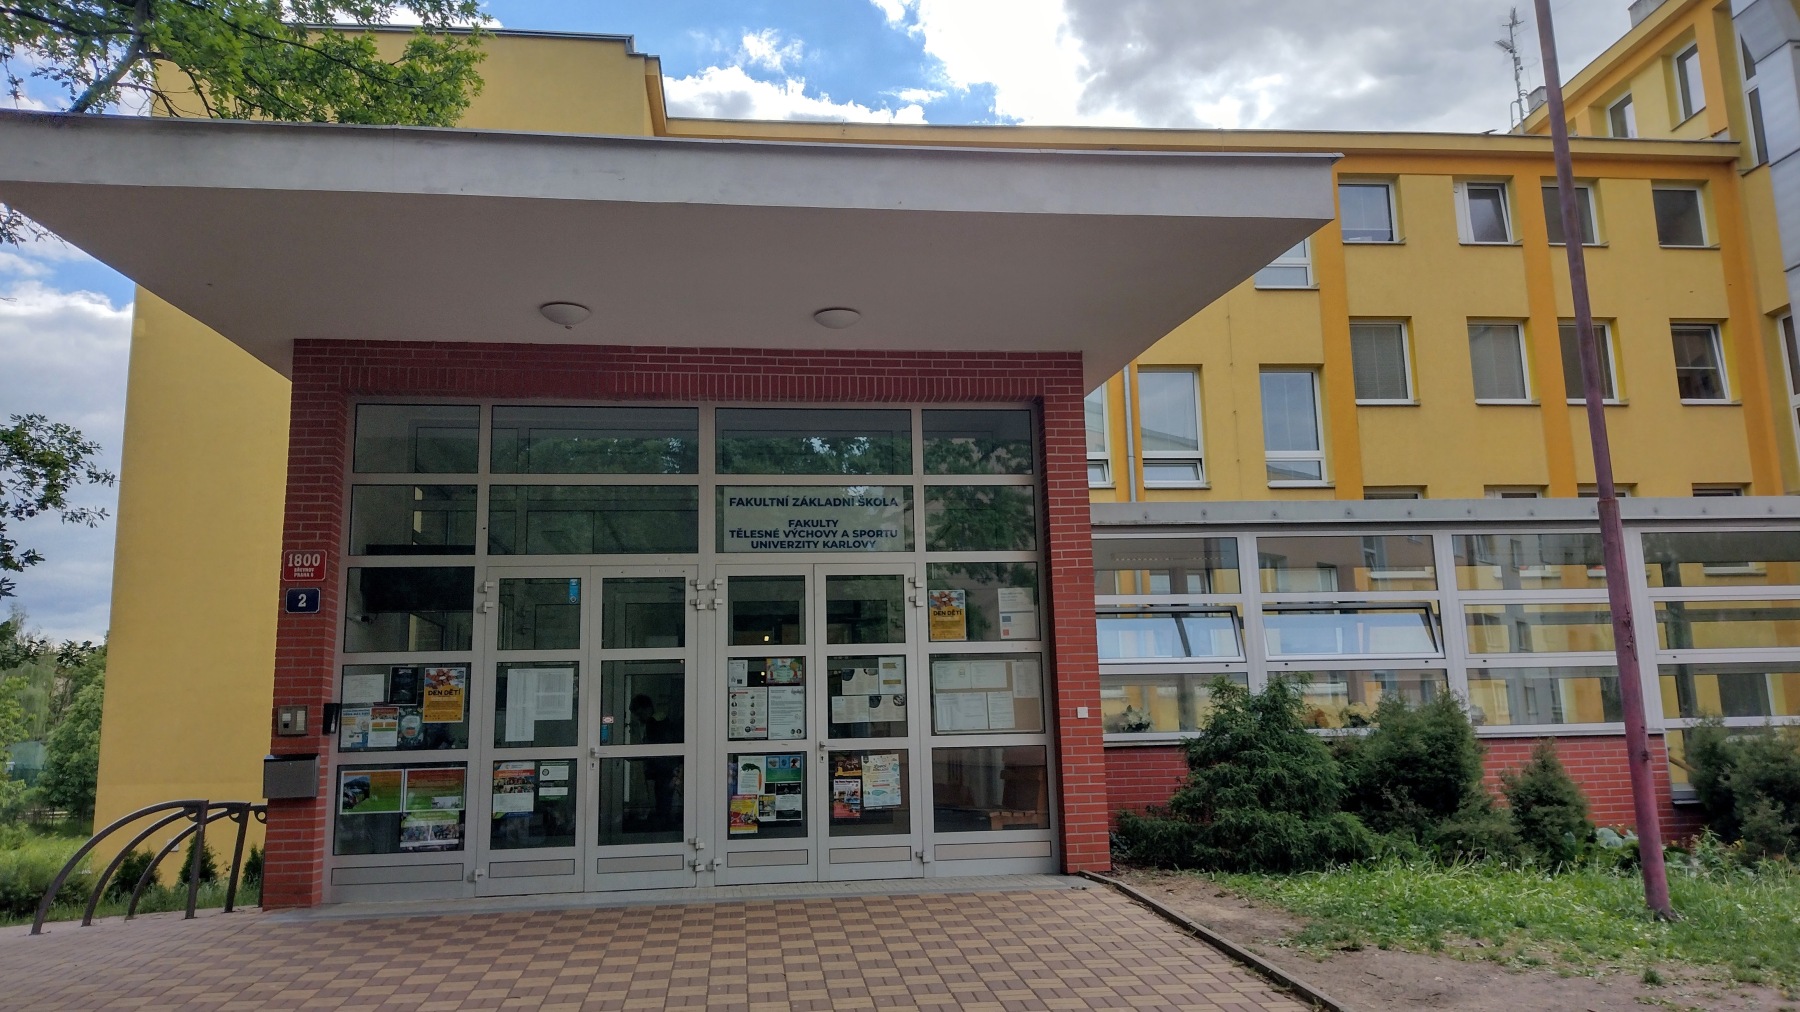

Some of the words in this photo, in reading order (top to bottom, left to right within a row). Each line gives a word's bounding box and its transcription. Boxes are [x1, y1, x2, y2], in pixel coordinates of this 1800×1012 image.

[729, 495, 789, 507] FAKULTNÍ
[792, 495, 855, 507] ZÁKLADNÍ
[858, 495, 899, 507] ŠKOLA
[788, 519, 839, 528] FAKULTY
[729, 528, 780, 538] TĚLESNÉ
[783, 528, 838, 538] VÝCHOVY
[841, 529, 850, 538] A
[852, 529, 898, 538] SPORTU
[751, 540, 819, 549] UNIVERZITY
[823, 540, 877, 549] KARLOVY
[288, 553, 320, 567] 1800
[297, 593, 307, 607] 2
[444, 688, 461, 696] DĚTÍ
